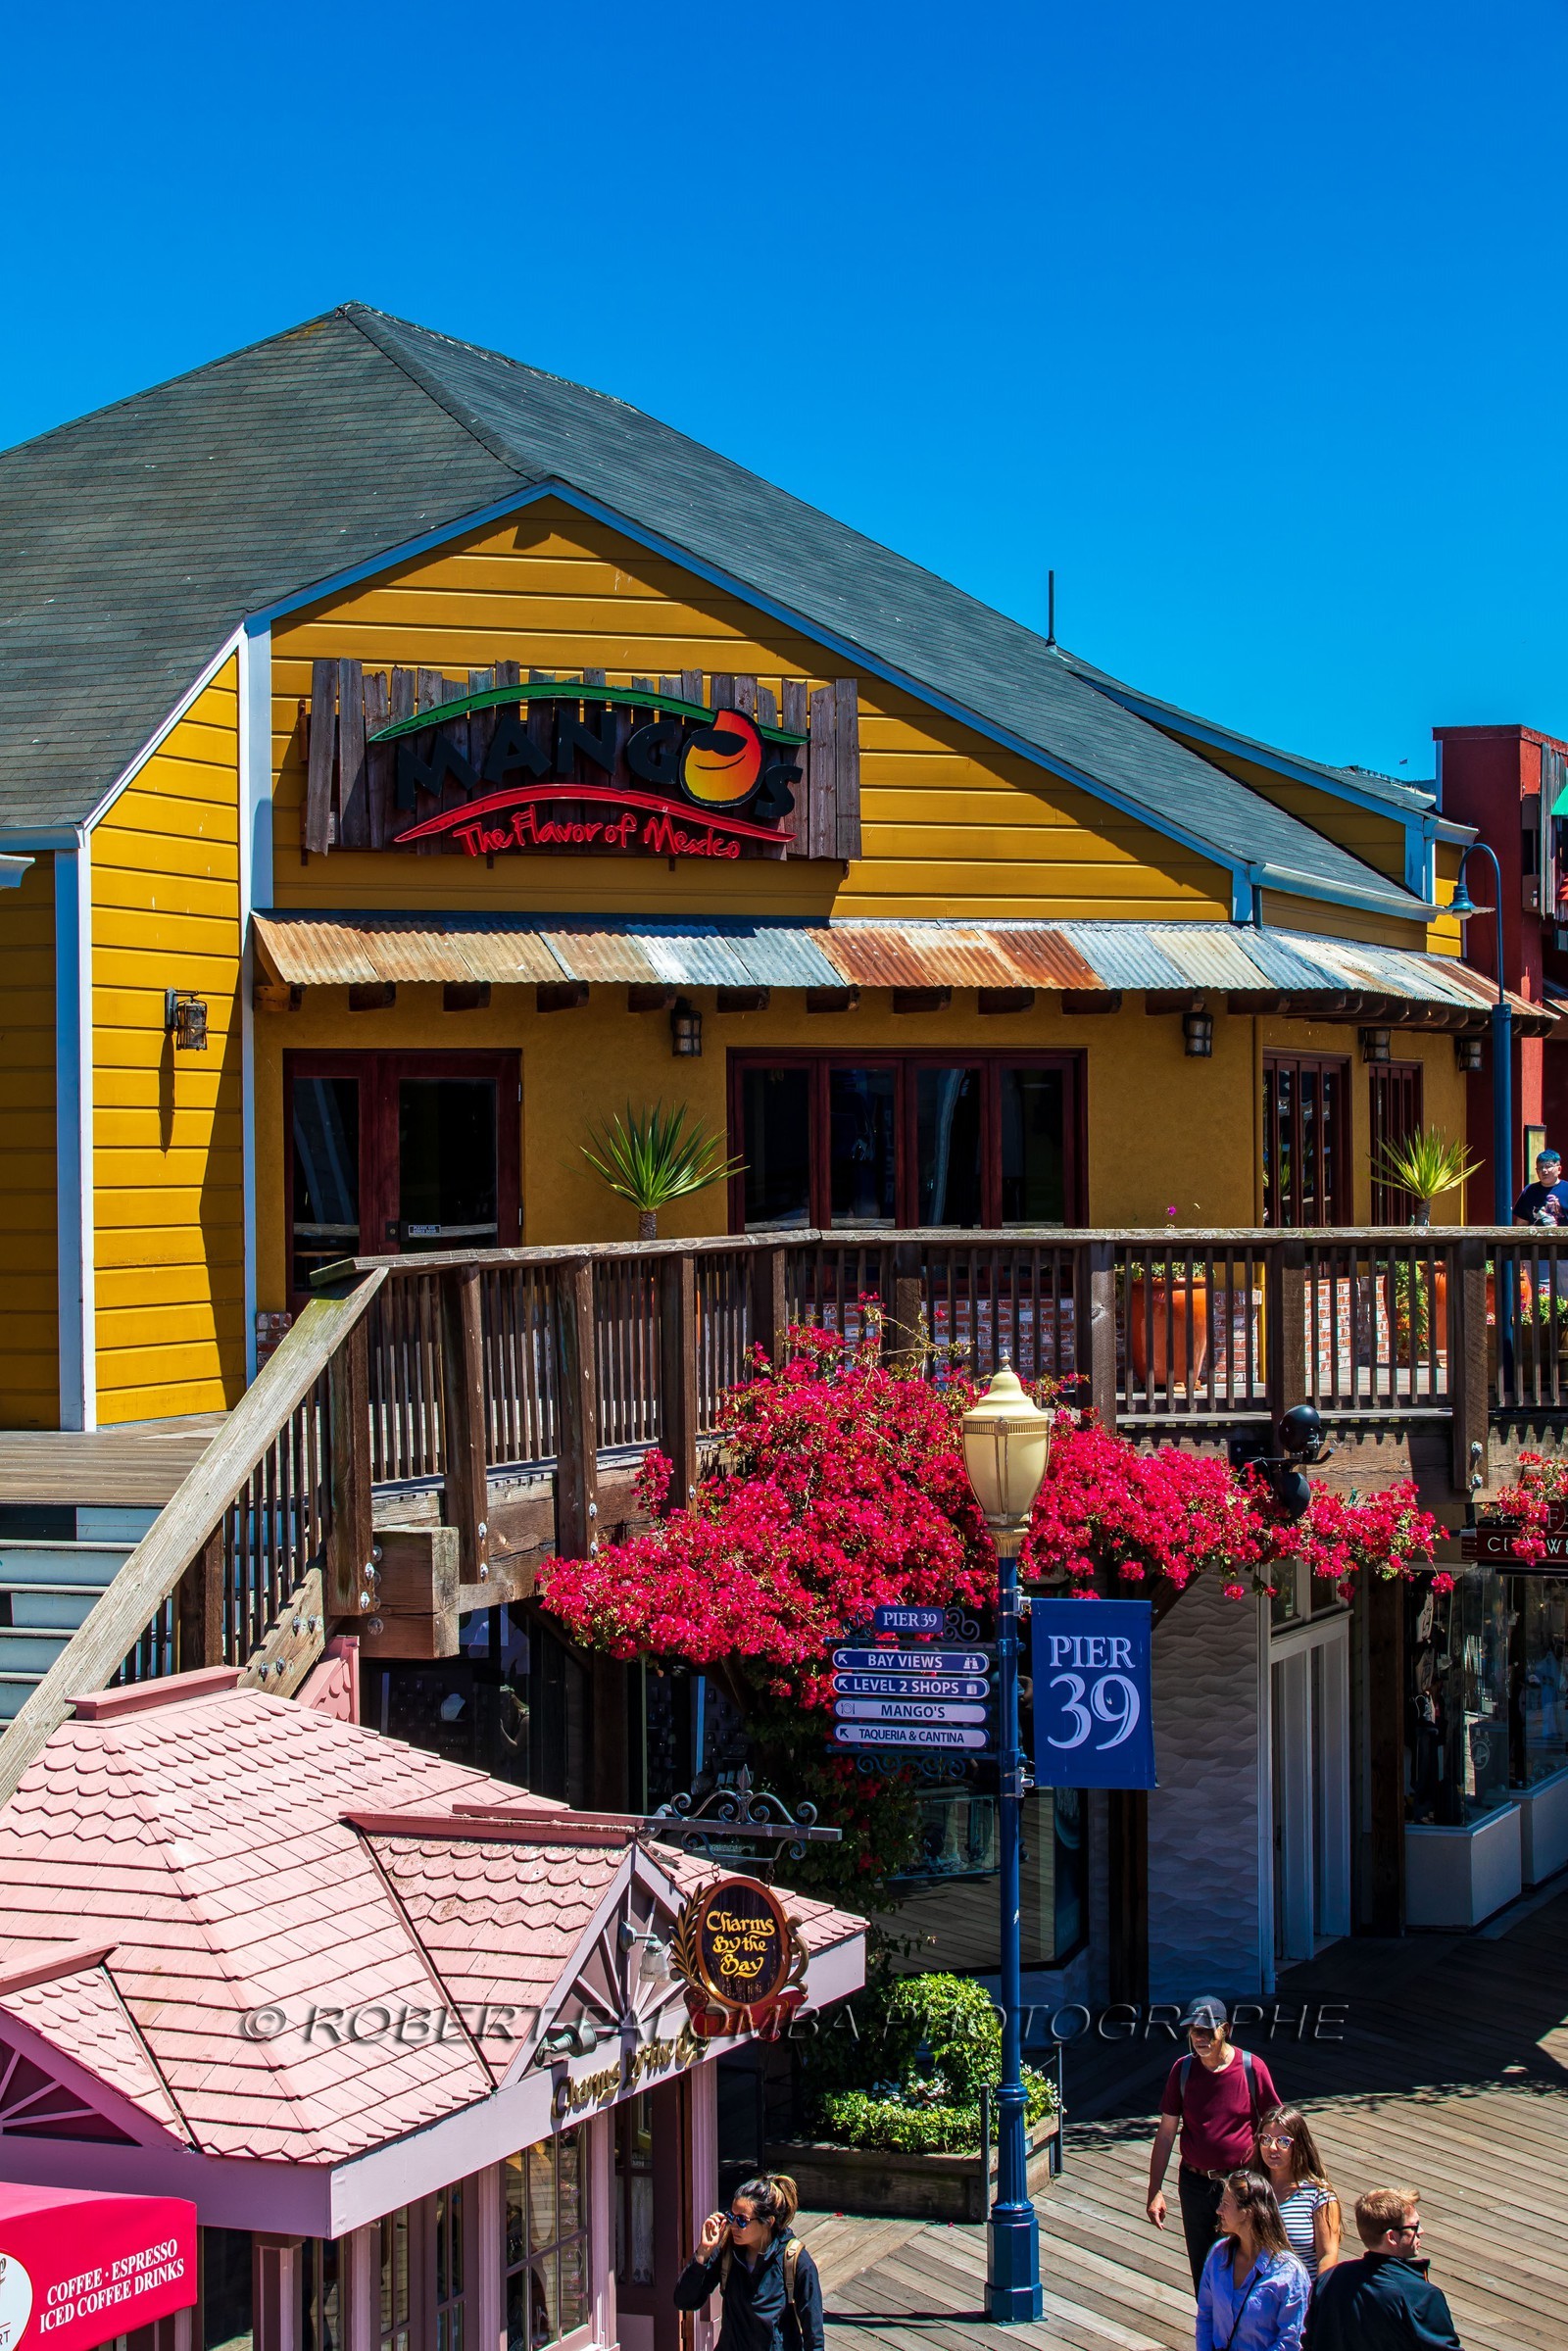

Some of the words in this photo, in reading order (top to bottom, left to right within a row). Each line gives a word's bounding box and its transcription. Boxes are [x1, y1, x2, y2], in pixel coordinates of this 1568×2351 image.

[453, 822, 513, 857] The
[511, 805, 601, 846] Flavor
[604, 812, 638, 849] of
[643, 815, 741, 859] Mexico
[883, 1611, 918, 1627] PIER
[921, 1613, 937, 1628] 39
[867, 1653, 896, 1667] BAY
[898, 1655, 943, 1669] VIEWS
[1048, 1635, 1136, 1668] PIER
[854, 1677, 896, 1691] LEVEL
[899, 1680, 907, 1692] 2
[911, 1681, 959, 1694] SHOPS
[881, 1703, 946, 1719] MANGO'S
[1047, 1672, 1141, 1750] 39
[859, 1728, 906, 1742] TAQUERIA
[908, 1730, 917, 1741] &
[918, 1731, 964, 1743] CANTINA
[707, 1910, 775, 1936] Charms
[712, 1935, 741, 1955] By
[742, 1935, 768, 1952] the
[720, 1953, 763, 1978] Bay
[47, 2267, 103, 2306] COFFEE
[111, 2238, 178, 2281] ESPRESSO
[39, 2303, 74, 2333] ICED
[76, 2279, 132, 2318] COFFEE
[134, 2258, 185, 2296] DRINKS
